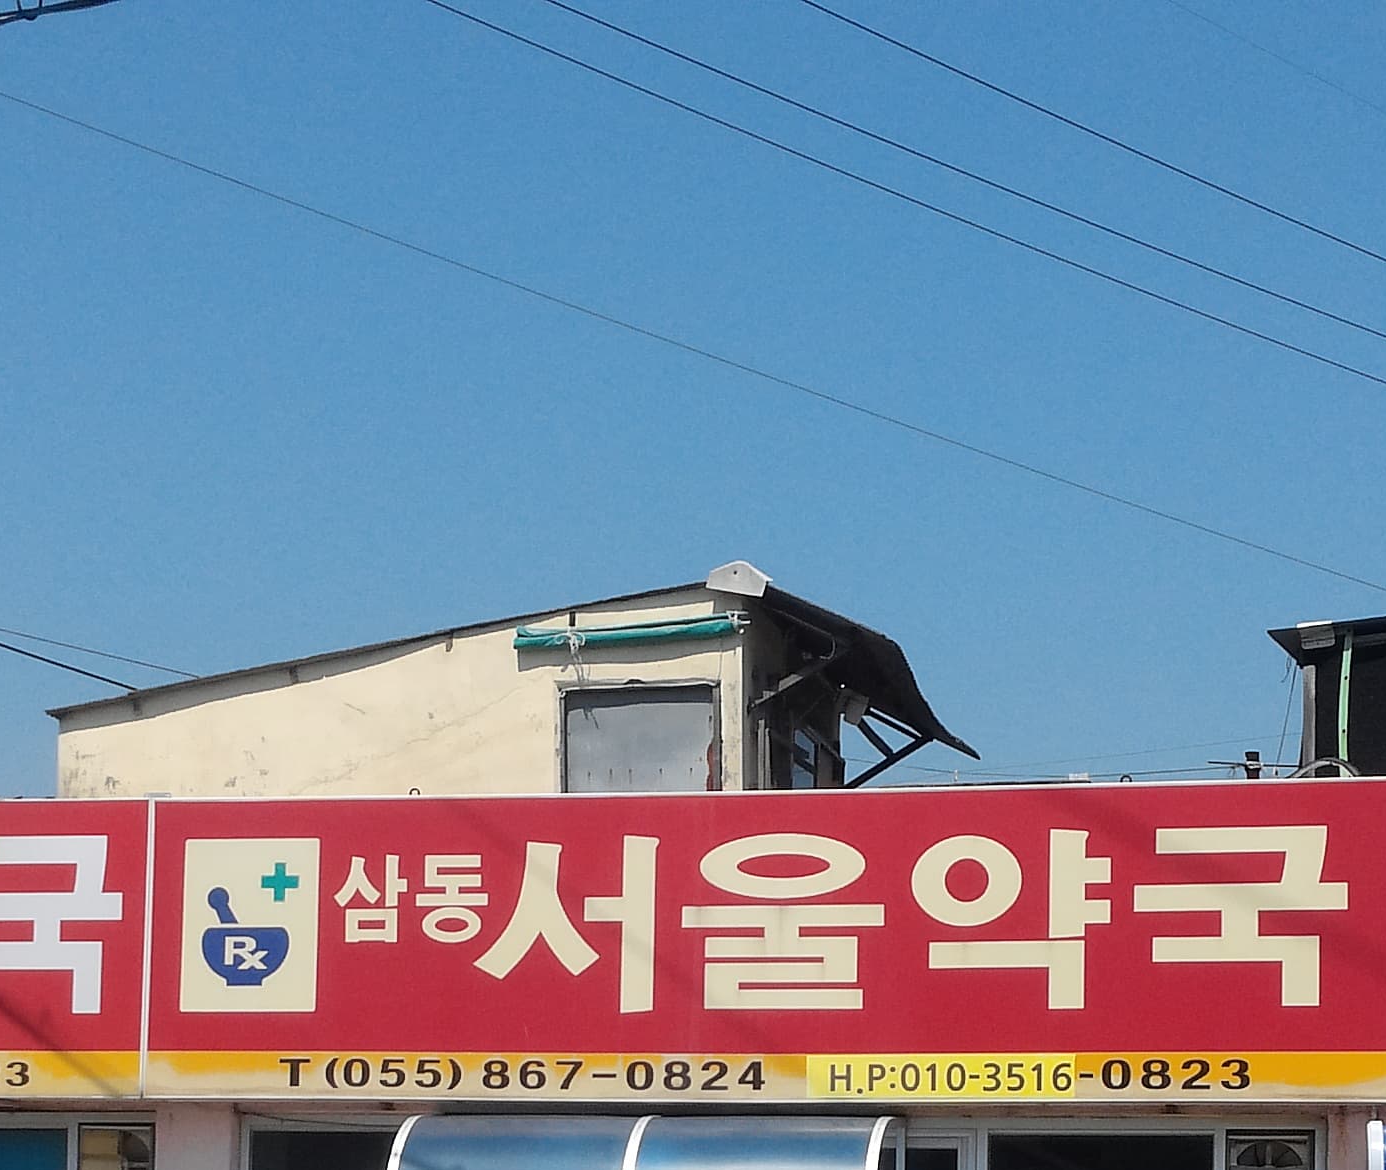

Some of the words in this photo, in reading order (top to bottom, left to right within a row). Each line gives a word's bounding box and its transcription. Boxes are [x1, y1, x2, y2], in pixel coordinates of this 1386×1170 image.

[334, 854, 489, 945] 삼동
[473, 824, 1349, 1014] 서울약국
[828, 1059, 1252, 1095] H.P:010-3516-0823
